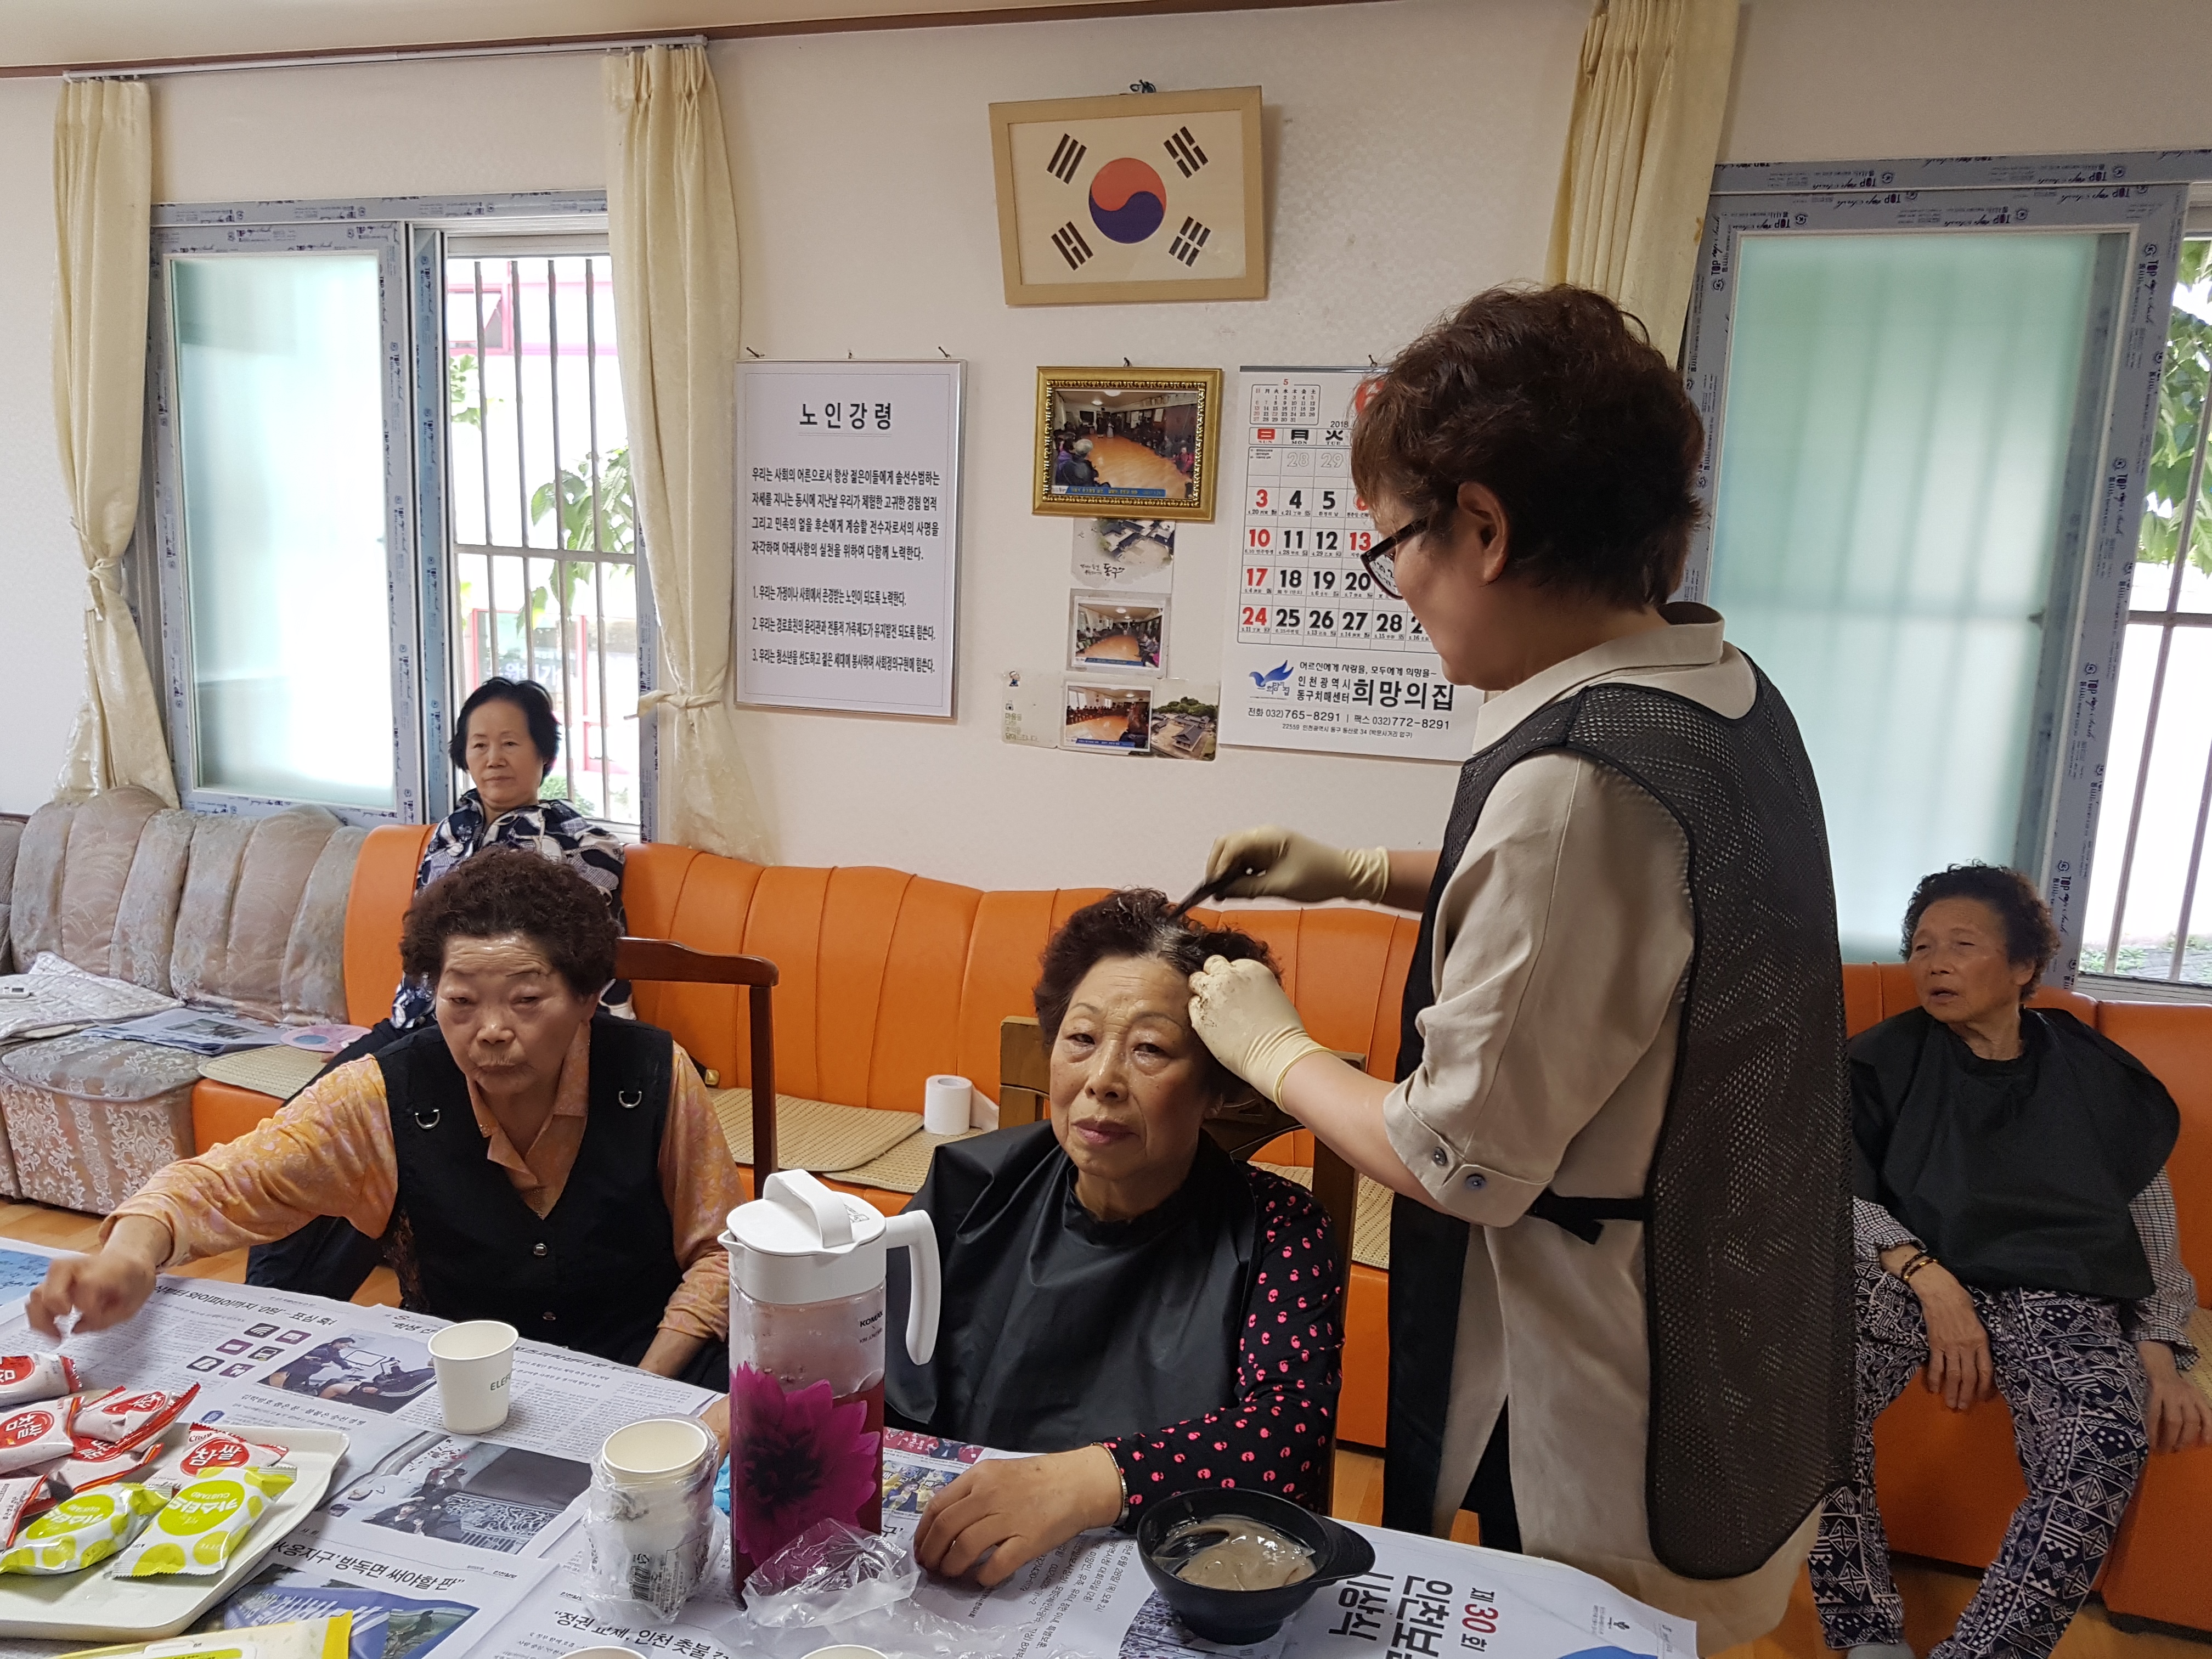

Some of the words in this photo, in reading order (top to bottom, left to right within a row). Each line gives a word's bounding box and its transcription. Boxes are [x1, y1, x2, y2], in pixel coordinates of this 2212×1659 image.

[799, 403, 893, 430] 노인강령
[1257, 428, 1276, 440] 日
[1291, 429, 1309, 441] 月
[1325, 430, 1344, 441] 火
[1287, 452, 1310, 467] 28
[1321, 453, 1344, 468] 29
[752, 467, 773, 482] 우리는
[775, 468, 795, 482] 사회의
[798, 469, 832, 483] 어른으로서
[834, 469, 849, 484] 항상
[851, 470, 894, 484] 젊은이들에게
[895, 471, 940, 486] 솔선수범하는
[752, 492, 772, 506] 자세를
[774, 493, 794, 506] 지니는
[795, 493, 815, 507] 동시에
[817, 494, 838, 508] 지난날
[839, 494, 860, 509] 우리가
[862, 495, 883, 509] 체험한
[884, 495, 906, 510] 고귀한
[907, 496, 921, 511] 경험
[923, 496, 937, 511] 업적
[1256, 489, 1268, 508] 3
[1289, 490, 1302, 509] 4
[1323, 491, 1336, 510] 5
[752, 517, 773, 531] 그리고
[775, 517, 796, 532] 민족의
[798, 518, 813, 532] 얼을
[815, 518, 844, 533] 후손에게
[846, 519, 867, 534] 계승할
[870, 520, 914, 535] 전수자로서의
[916, 521, 939, 537] 사명을
[1249, 529, 1271, 548] 10
[1284, 530, 1303, 549] 11
[1317, 531, 1338, 550] 12
[1350, 532, 1371, 551] 13
[752, 541, 780, 555] 자각하며
[782, 541, 817, 557] 아래사항의
[820, 543, 841, 558] 실천을
[843, 544, 865, 558] 위하여
[867, 545, 889, 560] 다함께
[891, 546, 924, 561] 노력한다.
[1246, 568, 1268, 586] 17
[1280, 569, 1302, 588] 18
[1313, 571, 1336, 590] 19
[1345, 572, 1371, 591] 20
[753, 585, 758, 599] 1.
[759, 585, 775, 600] 우리는
[777, 586, 798, 602] 가정이나
[799, 587, 821, 603] 사회에서
[822, 588, 844, 603] 존경받는
[846, 589, 862, 605] 노인이
[864, 590, 881, 606] 되도록
[882, 591, 906, 607] 노력한다.
[759, 617, 775, 632] 우리는
[776, 618, 803, 634] 경로효친의
[804, 619, 826, 635] 윤리관과
[828, 621, 844, 636] 전통적
[845, 622, 873, 637] 가족제도가
[874, 623, 896, 639] 유지발전
[898, 624, 916, 640] 되도록
[917, 625, 936, 641] 힘쓴다.
[1242, 607, 1267, 626] 24
[1276, 608, 1301, 628] 25
[1309, 610, 1334, 629] 26
[1342, 612, 1369, 631] 27
[1376, 613, 1402, 633] 28
[753, 648, 758, 662] 3.
[759, 648, 775, 663] 우리는
[776, 649, 798, 665] 청소년을
[799, 651, 821, 666] 선도하고
[822, 652, 833, 667] 젊은
[834, 653, 850, 668] 세대에
[852, 654, 874, 669] 봉사하며
[875, 655, 915, 672] 사회정의구현에
[916, 657, 935, 673] 힘쓴다.
[1299, 662, 1339, 673] 어르신에게
[1341, 664, 1368, 675] 사랑을,
[1371, 666, 1403, 676] 모두에게
[1298, 675, 1351, 690] 인천광역시
[1297, 690, 1350, 704] 동구치매센터
[1352, 679, 1454, 712] 희망의집
[1248, 707, 1263, 718] 전화
[1354, 714, 1370, 725] 팩스
[189, 1444, 242, 1466] 참쌀
[167, 1497, 239, 1514] 카스타드
[1117, 1556, 1128, 1567] 6월
[335, 1556, 388, 1579] 방독면
[386, 1568, 438, 1590] 써야할
[1088, 1567, 1107, 1592] 대회의실
[1110, 1568, 1123, 1582] 28일
[634, 1630, 674, 1649] 인천
[672, 1638, 711, 1659] 촛불
